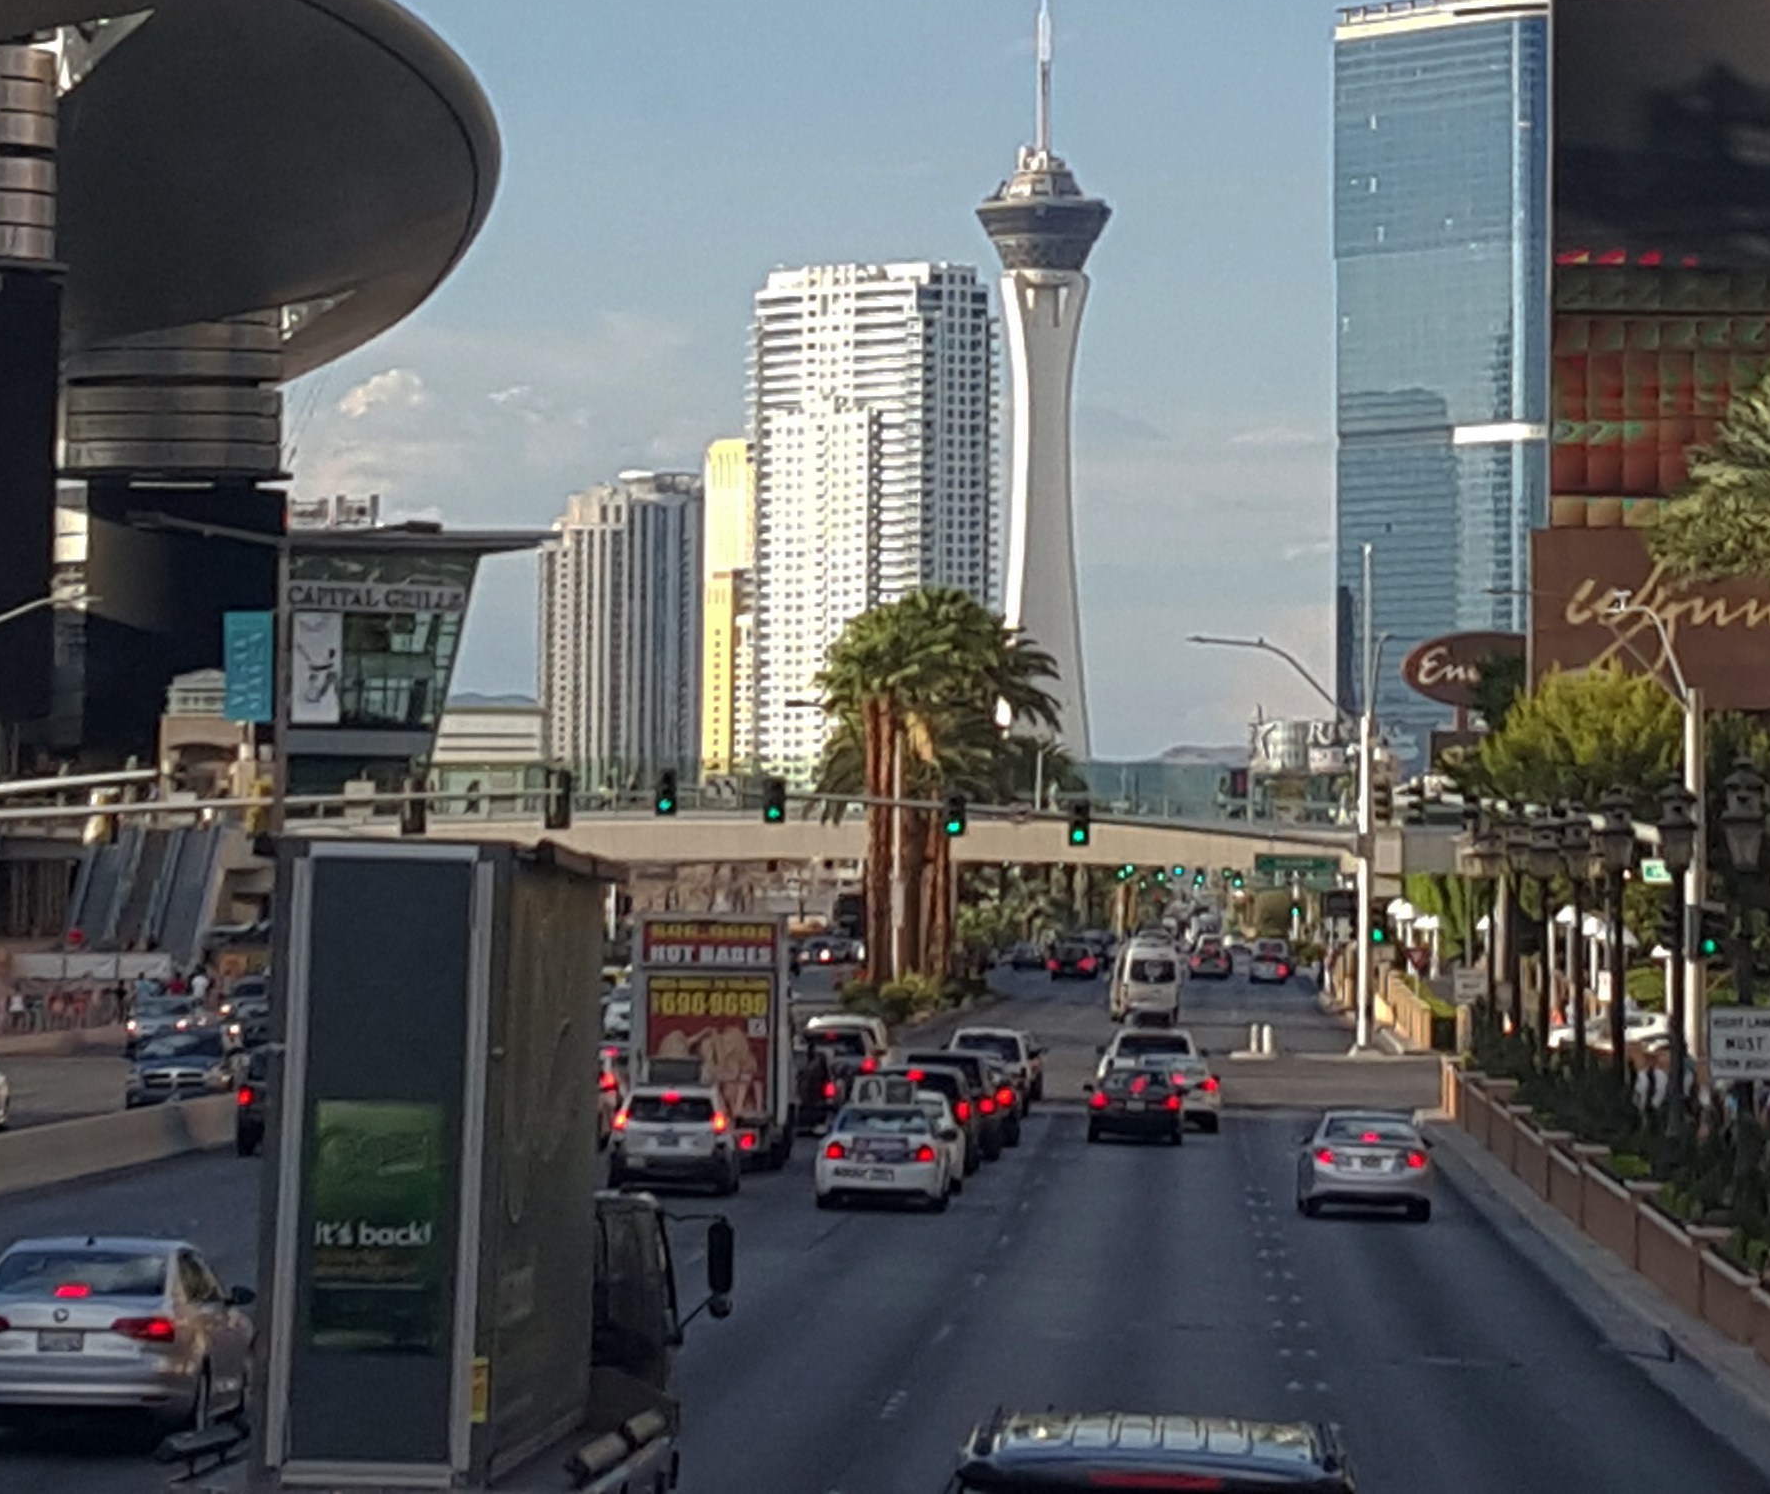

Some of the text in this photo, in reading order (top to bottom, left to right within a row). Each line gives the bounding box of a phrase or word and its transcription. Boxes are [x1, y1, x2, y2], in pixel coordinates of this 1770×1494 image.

[287, 585, 467, 610] CAPITAL GRILLE
[649, 944, 696, 964] HOT
[358, 1220, 433, 1246] back!
